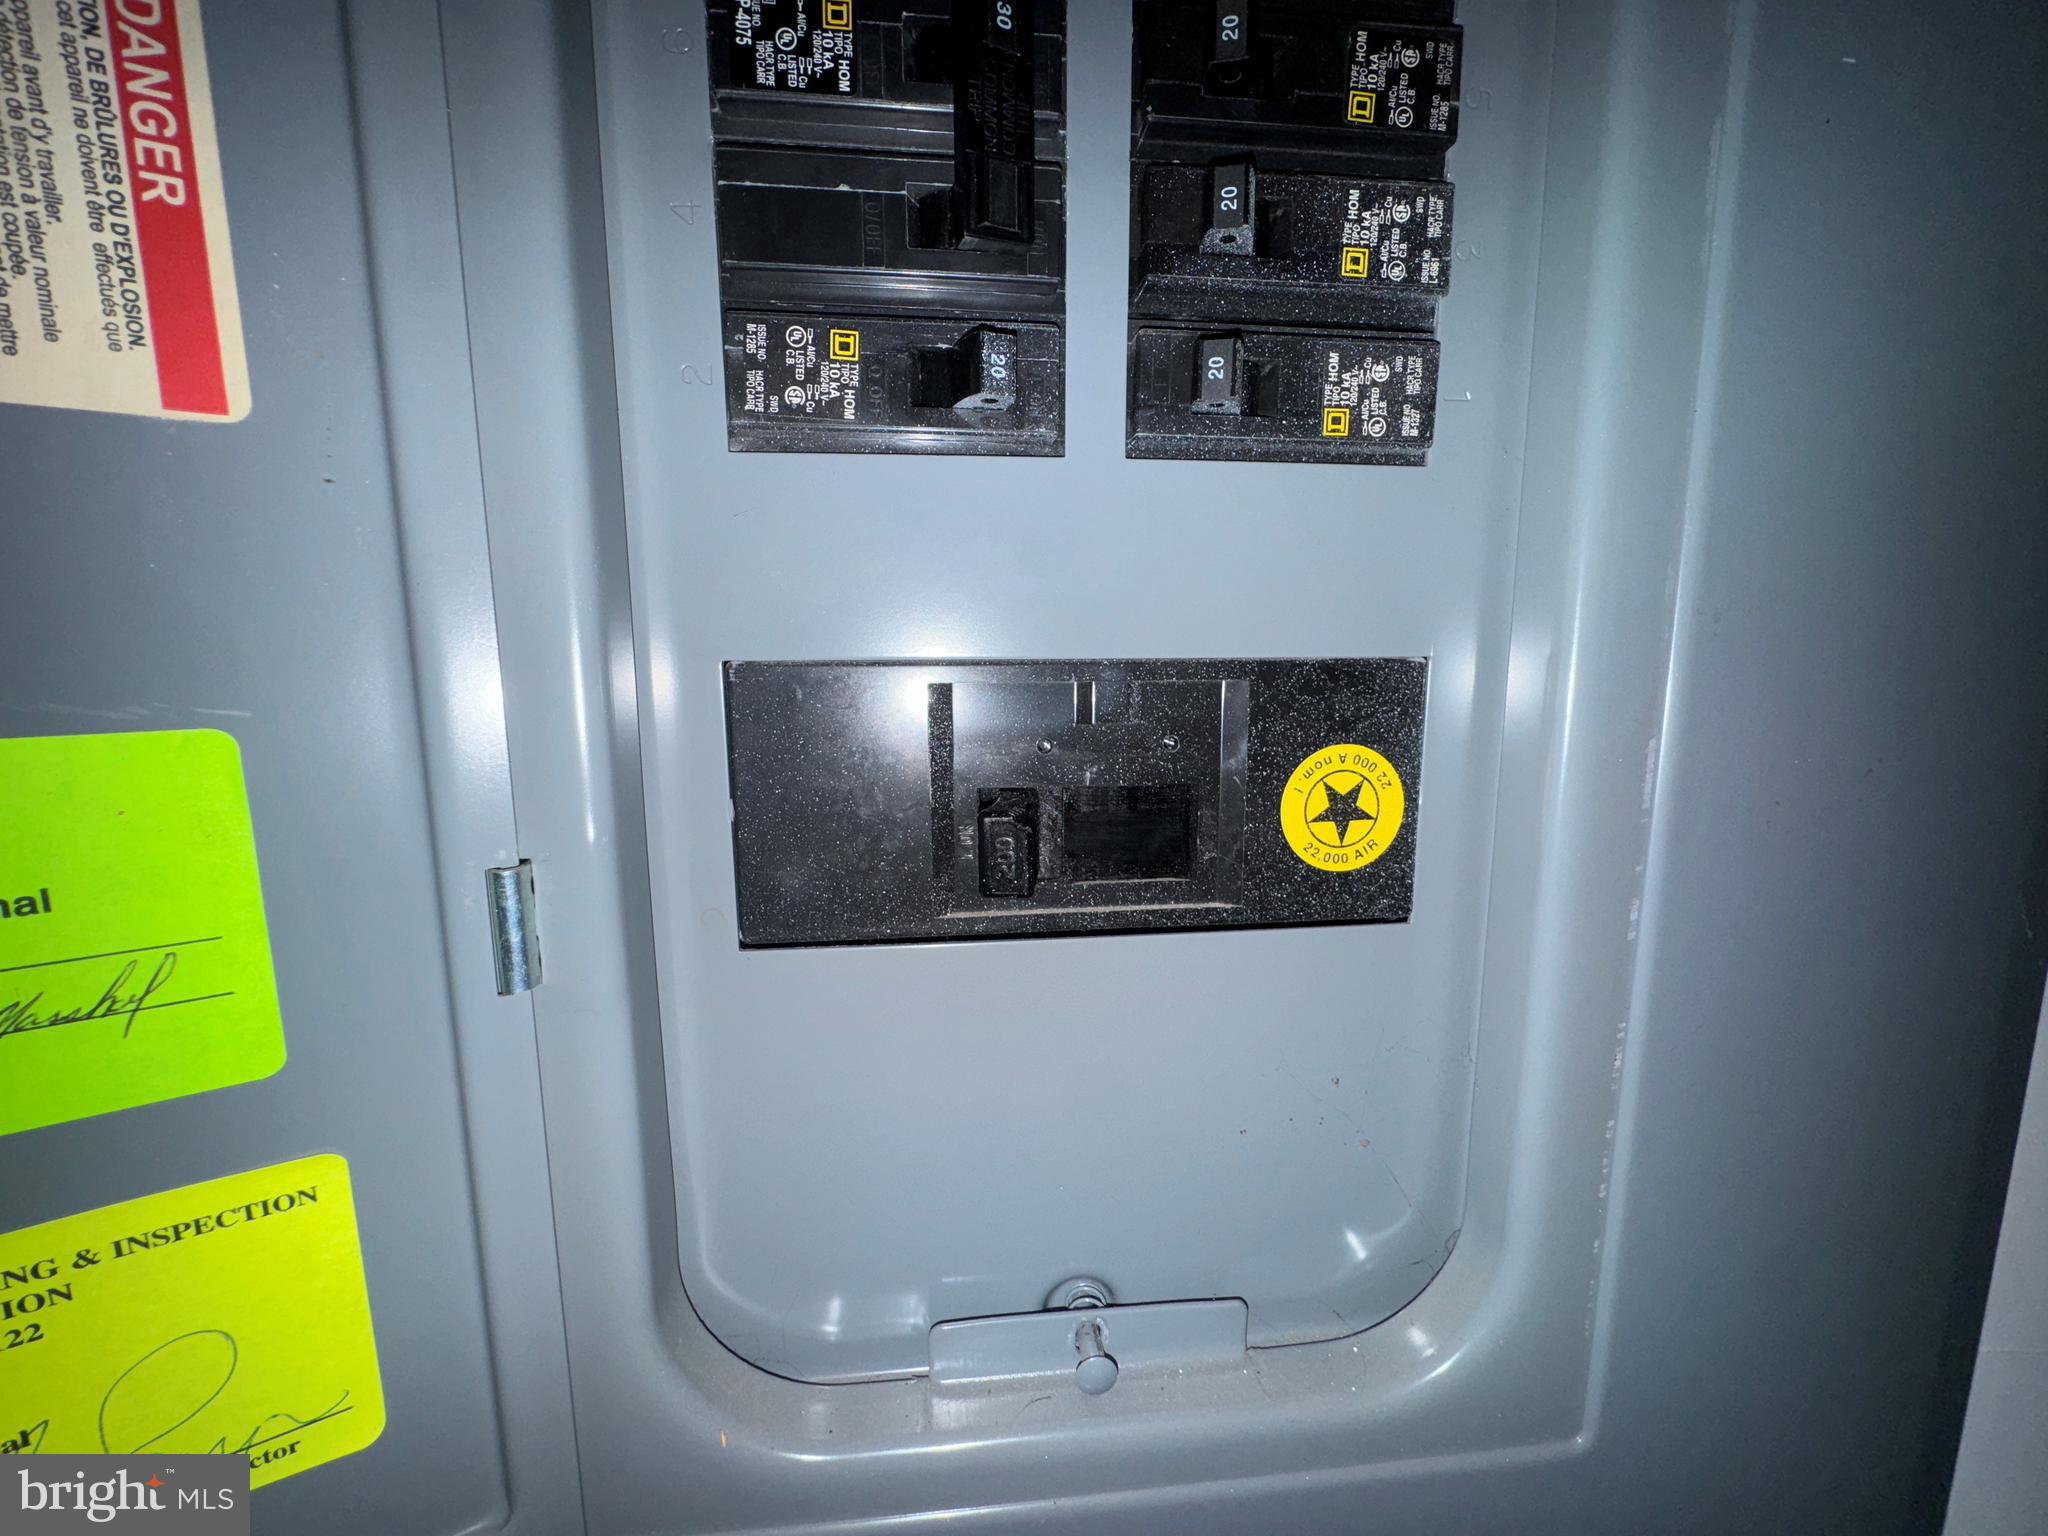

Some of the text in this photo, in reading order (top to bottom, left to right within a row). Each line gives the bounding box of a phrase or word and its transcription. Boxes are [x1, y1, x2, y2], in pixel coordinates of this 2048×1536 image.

[996, 0, 1012, 30] 30
[1222, 15, 1240, 41] 20
[812, 29, 823, 64] 120/240
[822, 30, 834, 70] 10 kA
[834, 31, 843, 55] TIPO
[1393, 40, 1402, 52] Cu
[1425, 41, 1434, 59] SWD
[755, 40, 766, 84] TIPO CARR
[765, 40, 775, 87] HACR TYPE
[777, 53, 787, 72] C.B.
[787, 54, 798, 88] LISTED
[838, 32, 854, 93] TYPE HOM
[1350, 31, 1368, 88] TYPE HOM
[1367, 53, 1379, 90] 10 kA
[1436, 42, 1448, 86] HACR TYPE
[798, 75, 808, 88] Cu
[1358, 67, 1368, 88] TIPO
[1377, 59, 1388, 91] 120/240
[1399, 73, 1408, 103] LISTED
[1443, 67, 1453, 86] TIPO
[5, 97, 27, 121] de
[115, 0, 186, 206] DANGER
[1407, 87, 1416, 105] C.B.
[1429, 107, 1439, 131] ISSUE
[1438, 101, 1450, 132] M-1285
[10, 125, 36, 189] tension
[22, 63, 48, 115] avant
[36, 148, 63, 225] travailler.
[56, 0, 124, 353] cet appareil ne doivent être effectués que
[77, 0, 148, 350] ION, DE BRÛLURES OU D'EXPLOSION.
[1221, 186, 1238, 211] 20
[1384, 196, 1393, 208] Cu
[1416, 196, 1424, 214] SWD
[1343, 189, 1360, 244] TYPE HOM
[1360, 210, 1372, 246] 10 kA
[1370, 215, 1379, 246] 120/240
[1427, 195, 1438, 238] HACR TYPE
[1434, 199, 1444, 237] TIPO CARR
[1, 211, 30, 280] coupée.
[24, 210, 46, 264] valeur
[1351, 223, 1360, 245] TIPO
[1391, 227, 1400, 257] LISTED
[1421, 261, 1430, 283] ISSUE
[1429, 257, 1440, 284] L-6961
[33, 265, 62, 344] nominale
[746, 323, 757, 354] M-1285
[757, 324, 766, 347] ISSUE
[786, 349, 795, 366] C.B.
[795, 350, 805, 381] LISTED
[989, 354, 1006, 379] 20
[1208, 356, 1224, 380] 20
[1364, 357, 1372, 369] Cu
[1395, 355, 1403, 373] SWD
[746, 369, 755, 387] TIPO
[820, 360, 829, 393] 120/240
[829, 362, 840, 399] 10 kA
[840, 363, 850, 384] TIPO
[1324, 352, 1340, 406] TYPE HOM
[1406, 355, 1416, 395] HACR TYPE
[1414, 357, 1423, 395] TIPO CARR
[755, 370, 764, 413] HACR TYPE
[769, 395, 779, 413] SWD
[843, 363, 859, 420] TYPE HOM
[1332, 386, 1341, 406] TIPO
[1340, 372, 1351, 406] 10 kA
[1349, 377, 1359, 406] 120/240
[1371, 387, 1380, 415] LISTED
[806, 401, 815, 413] Cu
[1402, 415, 1411, 437] ISSUE
[1409, 409, 1420, 437] M-1327
[1339, 753, 1348, 764] A
[1353, 754, 1378, 773] 000
[1376, 770, 1393, 790] 22
[1303, 838, 1379, 864] 22,000 AIR
[72, 1249, 101, 1270] &
[112, 1186, 320, 1260] INSPECTION
[0, 1283, 73, 1321] ION
[4, 1323, 44, 1349] 22
[249, 1440, 302, 1469] ctor
